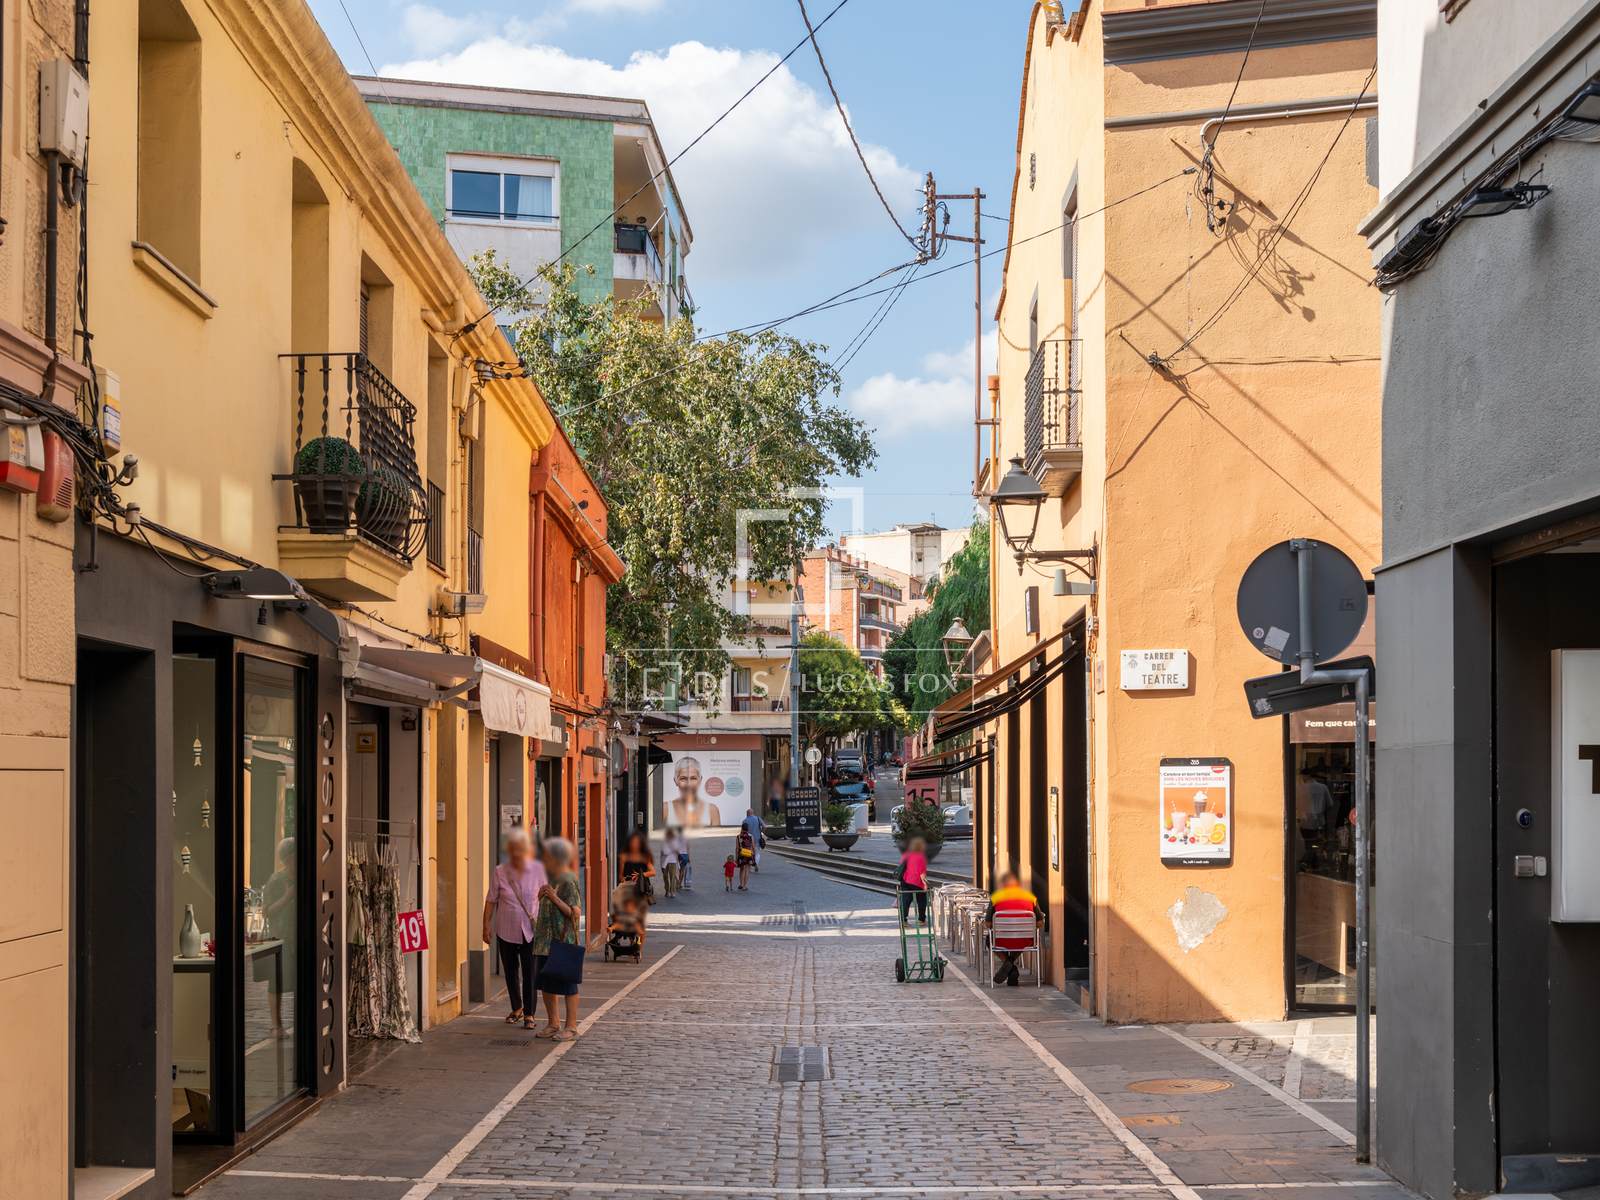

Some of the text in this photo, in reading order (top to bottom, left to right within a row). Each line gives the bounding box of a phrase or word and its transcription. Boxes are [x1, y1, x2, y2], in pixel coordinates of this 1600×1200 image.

[1144, 652, 1174, 660] CARRER
[1151, 663, 1166, 671] DEL
[1142, 673, 1179, 685] TEATRE
[1325, 720, 1343, 728] que
[399, 916, 421, 950] 19
[321, 879, 335, 1076] CUGAT
